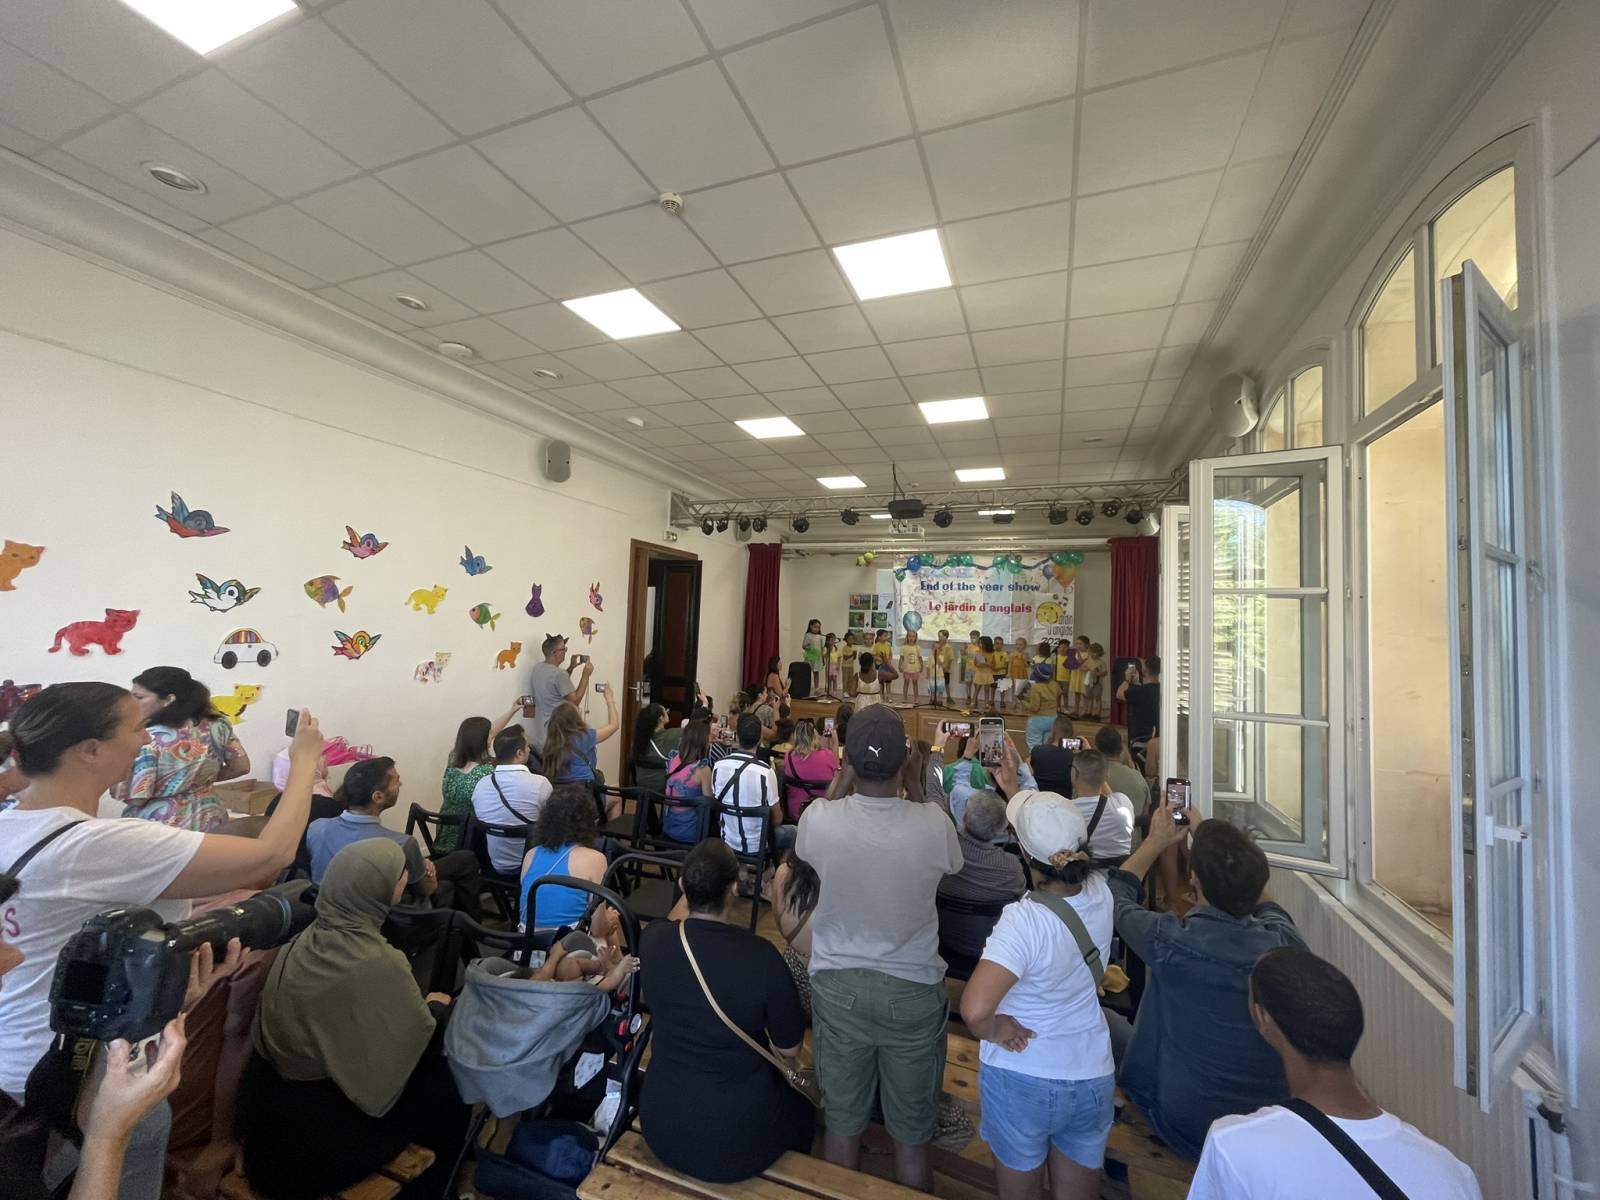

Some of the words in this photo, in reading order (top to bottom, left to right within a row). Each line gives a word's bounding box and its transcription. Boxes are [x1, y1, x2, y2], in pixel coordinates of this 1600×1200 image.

[920, 580, 939, 591] End
[942, 580, 954, 591] of
[957, 581, 976, 592] the
[979, 583, 1004, 593] year
[1008, 581, 1041, 592] show
[928, 601, 941, 612] Le
[944, 601, 976, 613] jardin
[979, 602, 1032, 615] d'anglais
